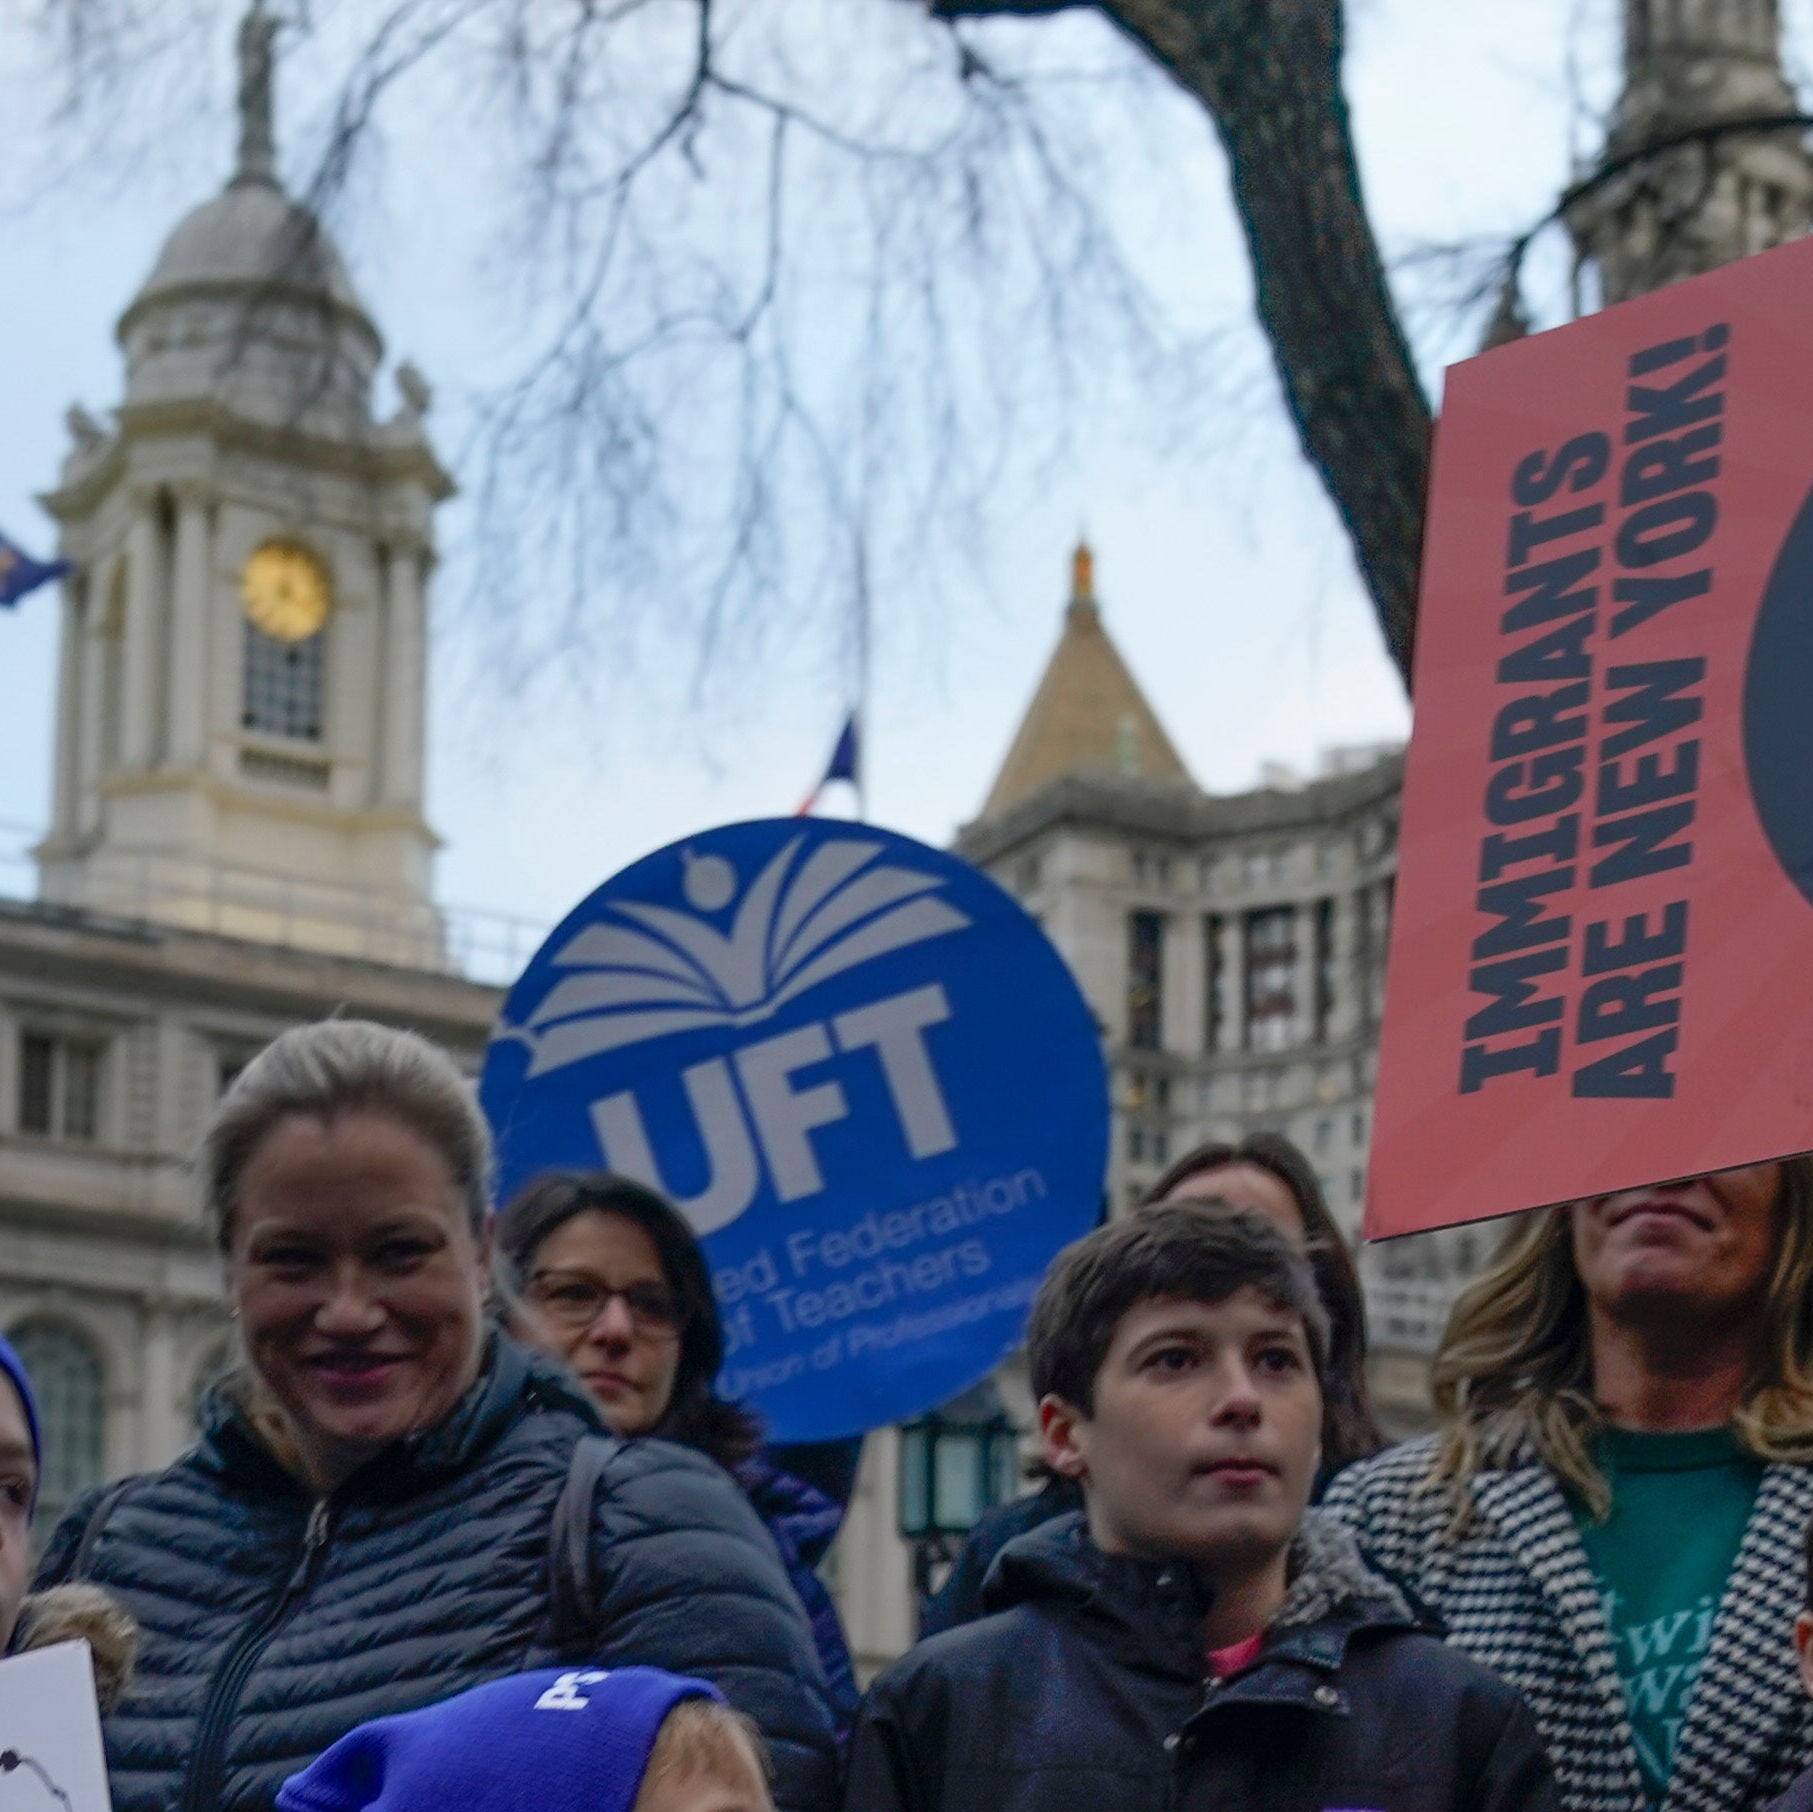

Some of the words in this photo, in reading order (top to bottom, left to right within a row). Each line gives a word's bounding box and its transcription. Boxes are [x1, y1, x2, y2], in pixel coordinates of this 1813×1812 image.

[1609, 323, 1729, 640] YORK!
[1459, 432, 1610, 1095] IMMIGRANTS
[1588, 656, 1706, 890] NEW
[590, 982, 958, 1237] UFT
[1571, 899, 1689, 1099] ARE
[768, 1240, 989, 1335] Teachers
[785, 1168, 1045, 1277] Federation
